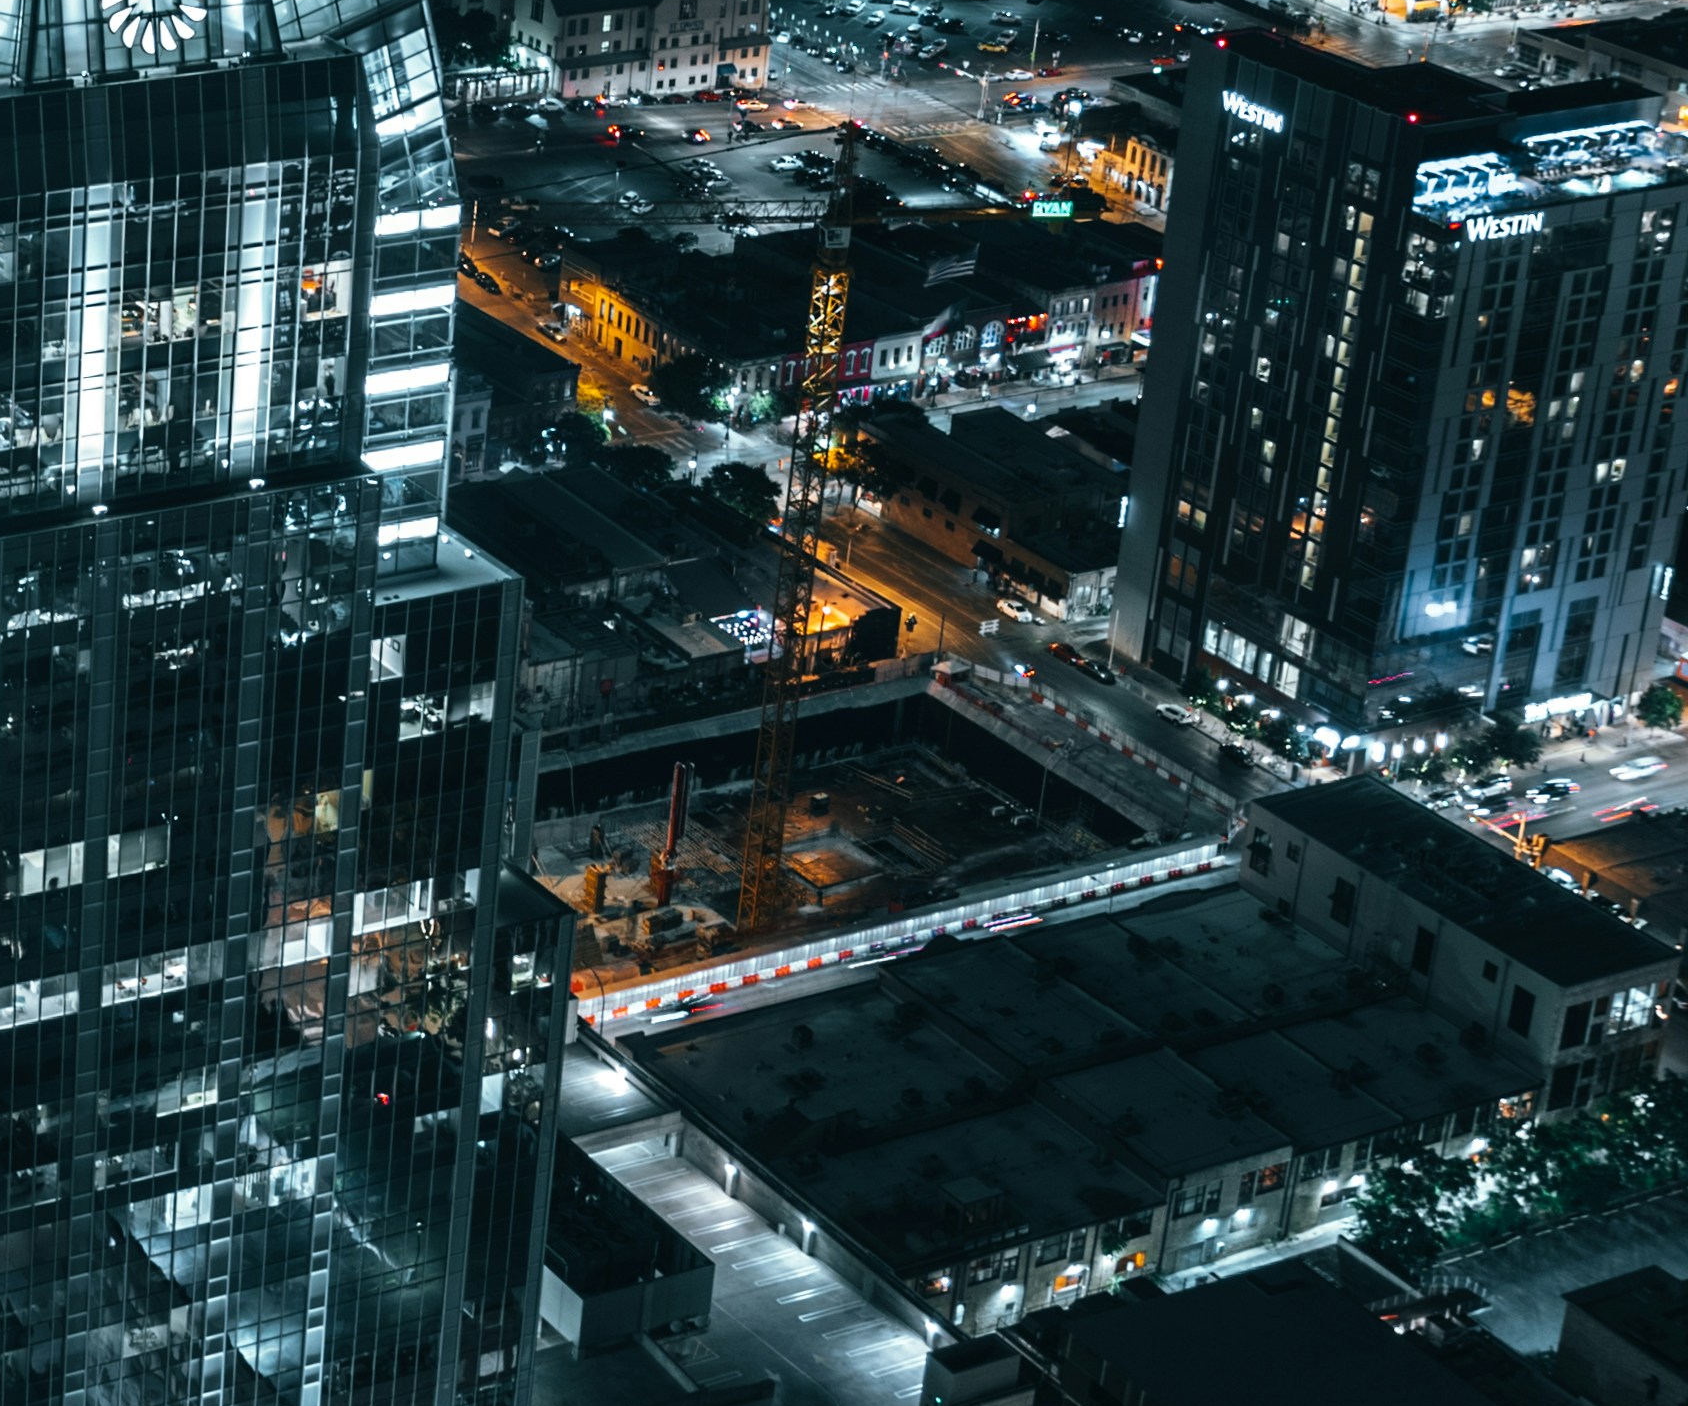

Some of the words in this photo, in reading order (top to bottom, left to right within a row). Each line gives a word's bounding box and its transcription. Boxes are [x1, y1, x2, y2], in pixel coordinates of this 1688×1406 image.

[1222, 90, 1283, 133] WESTIN
[1033, 201, 1073, 215] RYAN
[1465, 212, 1544, 242] WESTIN
